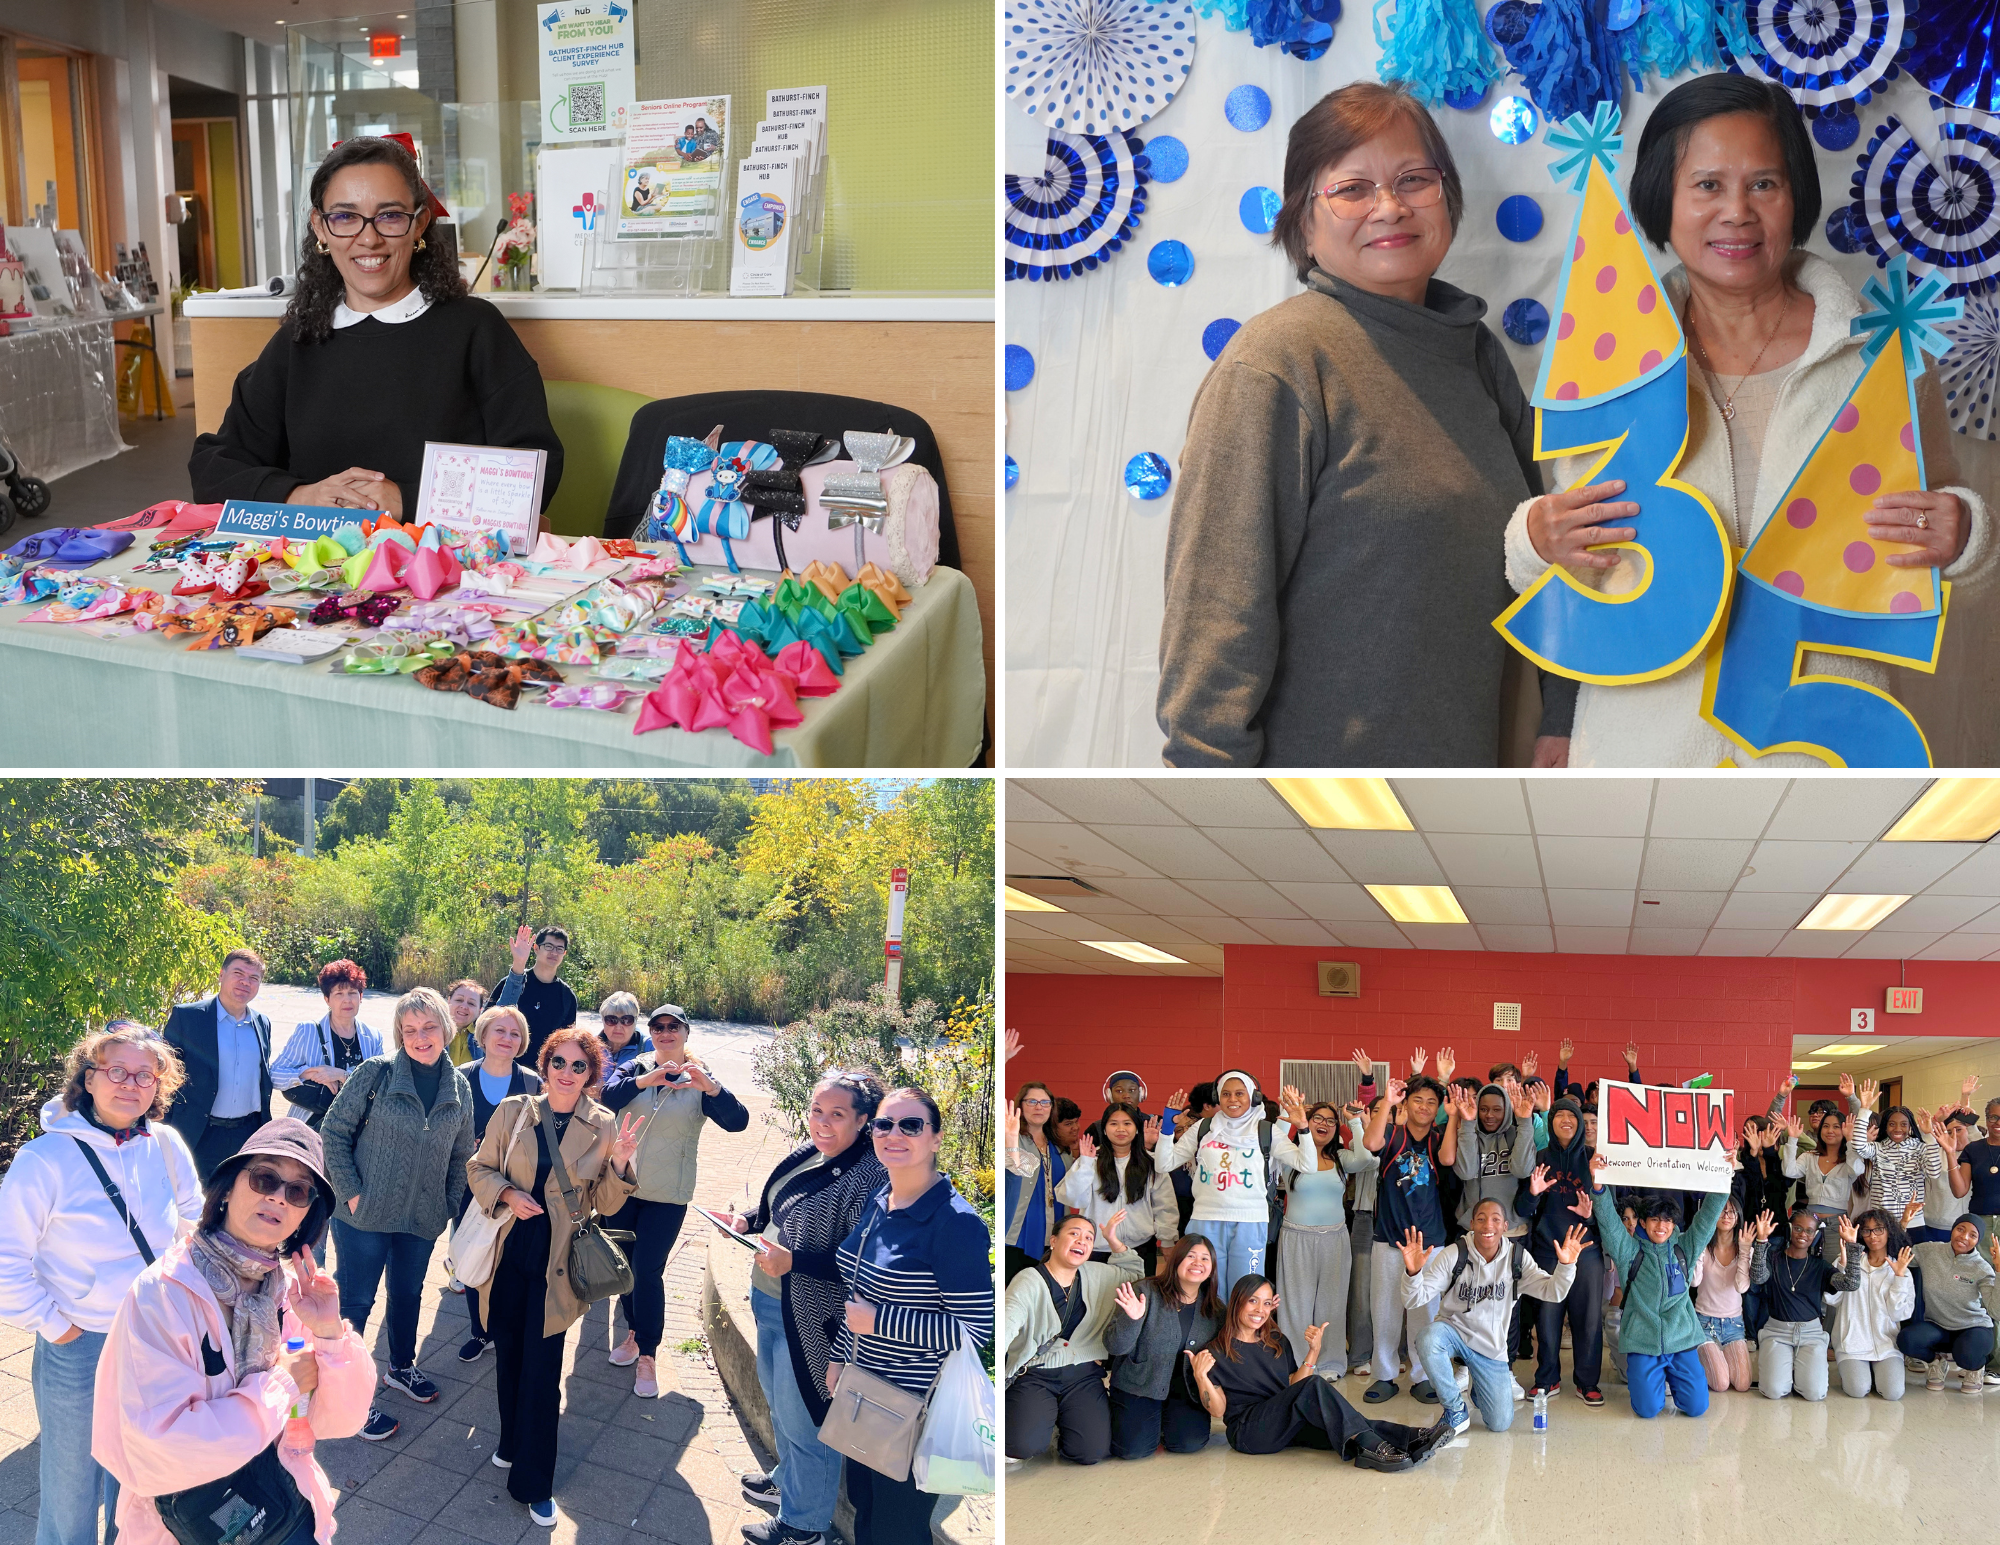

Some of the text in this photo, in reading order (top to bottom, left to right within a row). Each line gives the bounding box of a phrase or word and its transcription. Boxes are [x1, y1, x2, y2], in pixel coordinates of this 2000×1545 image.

[574, 7, 591, 16] hub
[569, 21, 585, 29] WANT
[557, 25, 614, 40] FROM YOU!
[548, 44, 607, 57] BATHURST-FINCH
[552, 50, 620, 62] CLIENT EXPERIENCE
[572, 59, 599, 67] SURVEY
[771, 92, 820, 103] BATHURST-FINCH
[640, 101, 708, 111] Seniors Online Program
[772, 108, 817, 118] BATHURST-FINCH
[761, 122, 805, 133] BATHURST-FINCH
[755, 143, 799, 153] BATHURST-FINCH
[743, 163, 788, 172] BATHURST-FINCH
[763, 202, 785, 211] EMPOWER
[504, 468, 534, 480] BOWTIQUE
[480, 479, 531, 491] Where every bow
[490, 487, 505, 496] little
[491, 497, 499, 506] of
[226, 507, 290, 531] Maggi's
[482, 518, 529, 531] MAGGIS BOWTIQUE
[1893, 990, 1918, 1009] EXIT
[1857, 1011, 1868, 1030] 3
[1607, 1084, 1734, 1151] NOW
[1219, 1151, 1232, 1172] &
[1600, 1155, 1642, 1168] Newcomer
[1647, 1156, 1691, 1171] Orientation
[1199, 1164, 1254, 1192] bright
